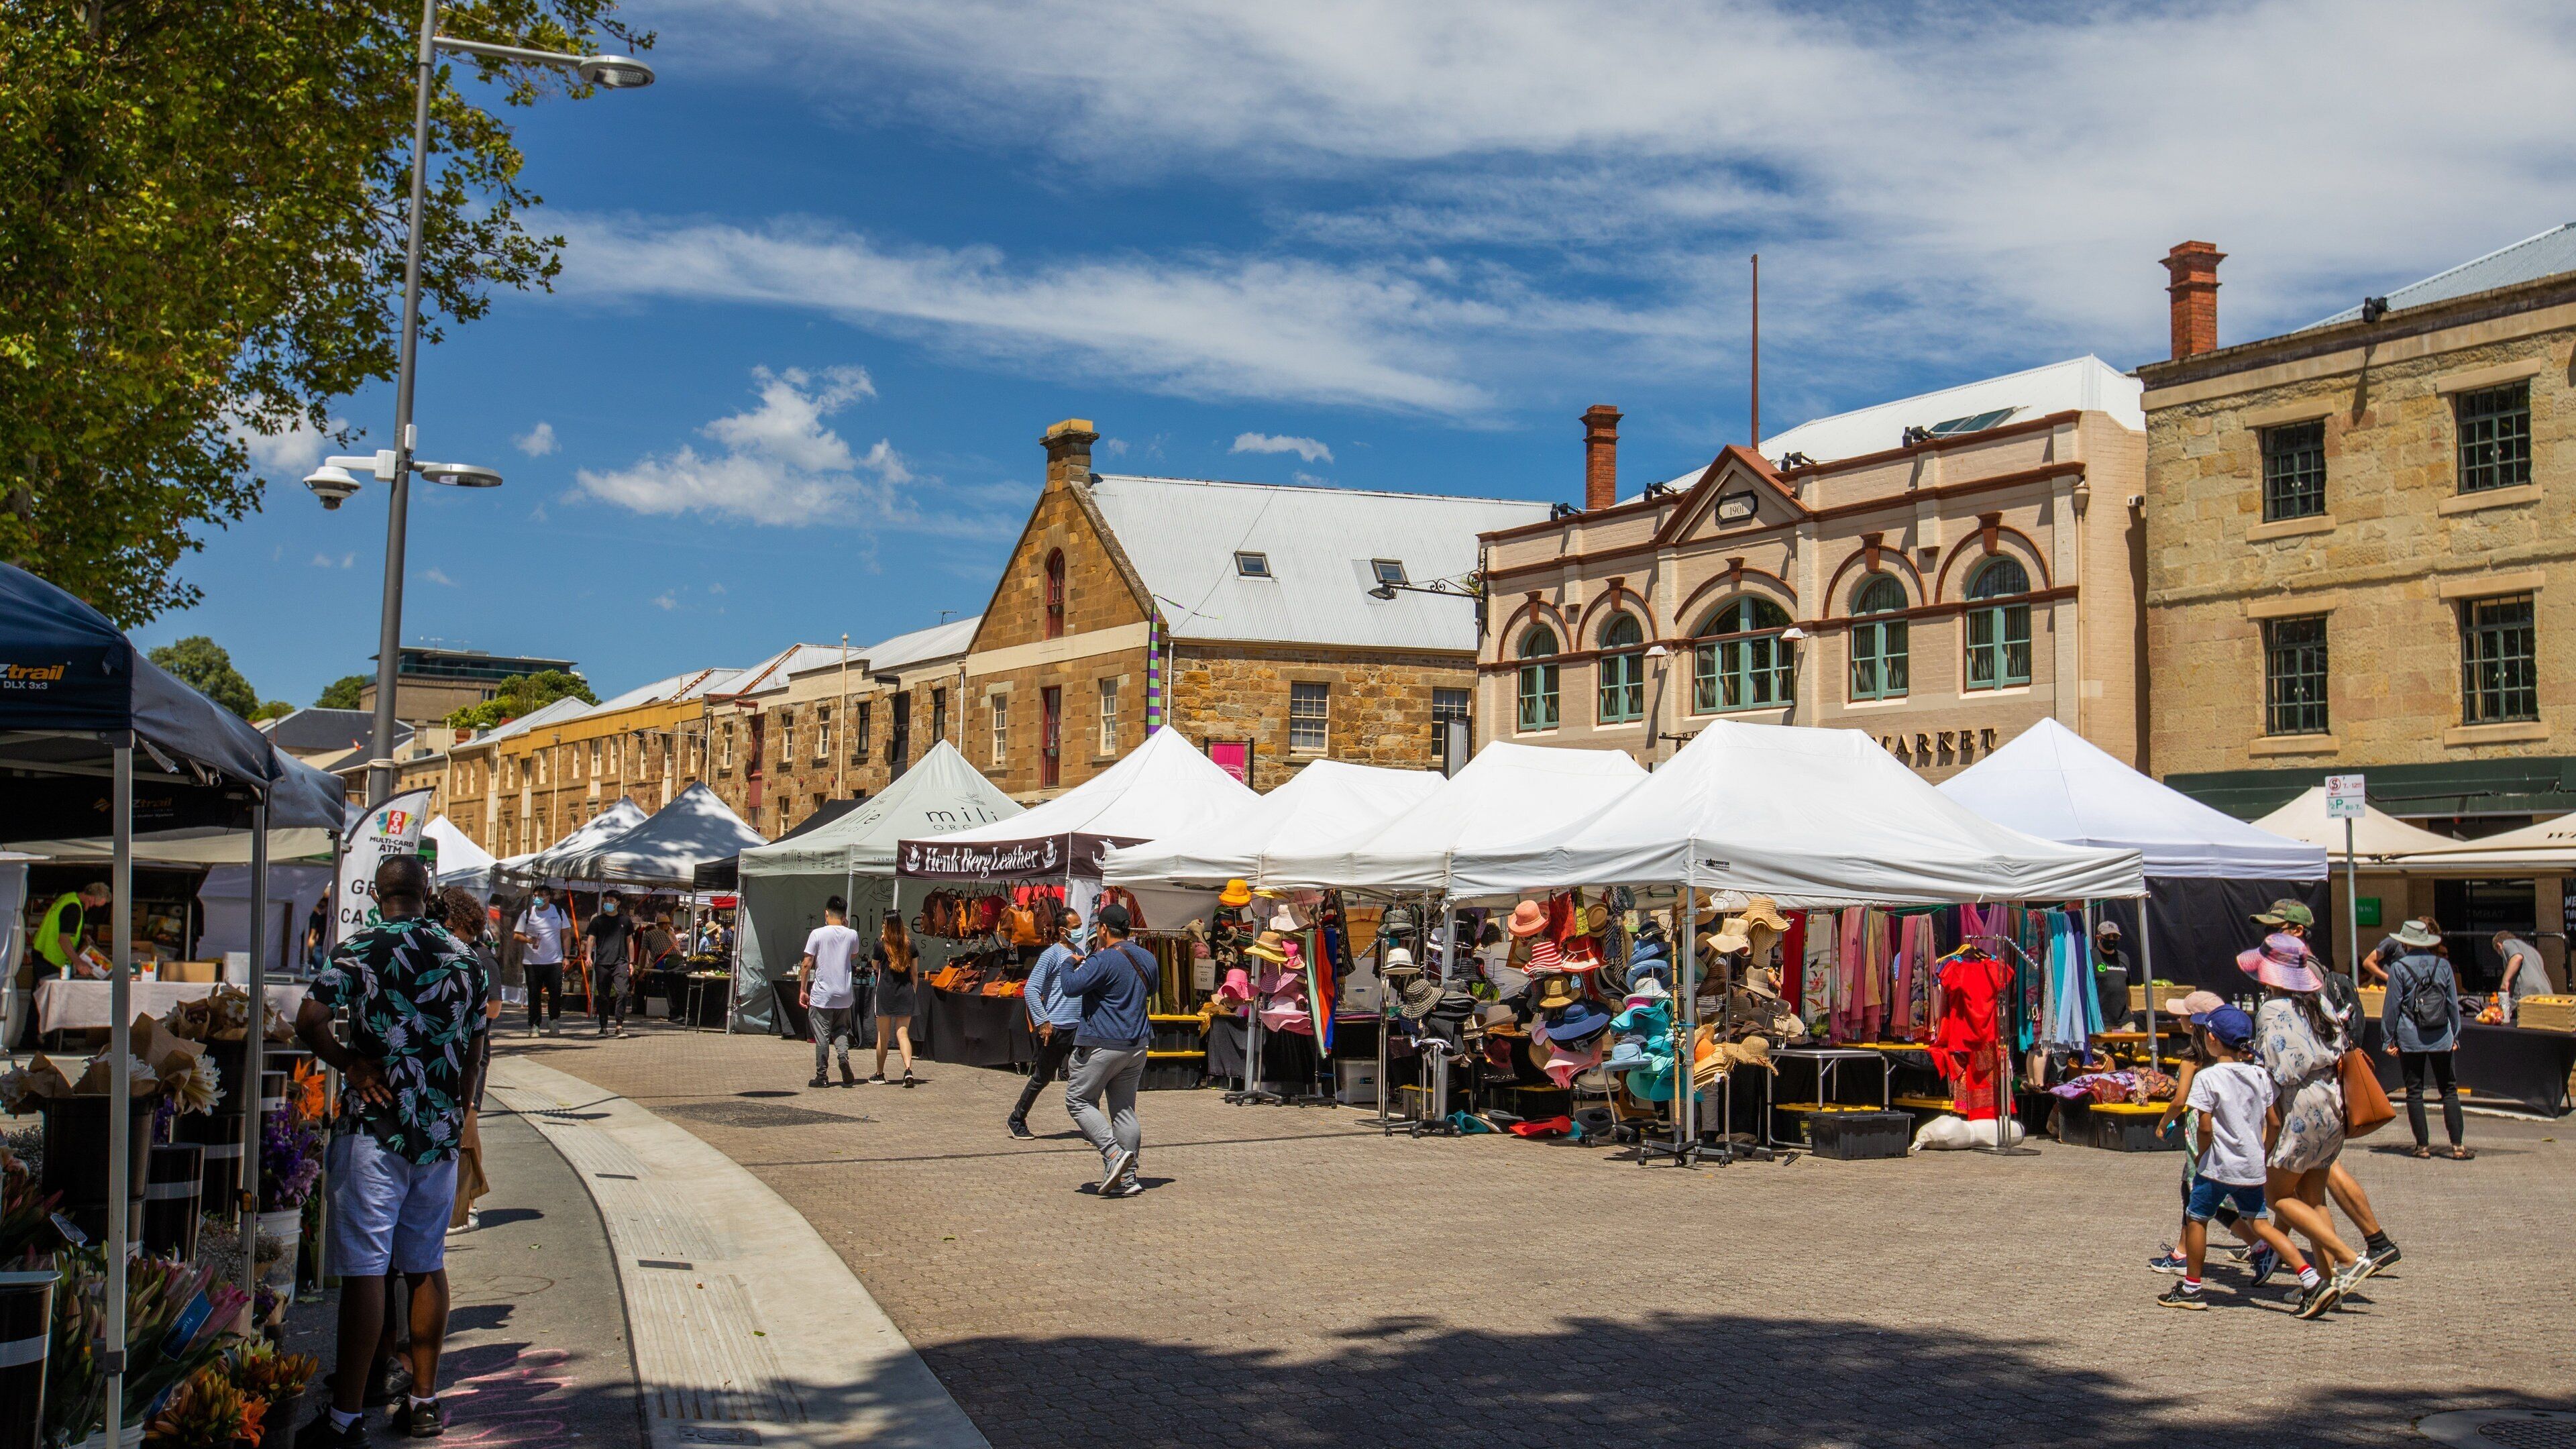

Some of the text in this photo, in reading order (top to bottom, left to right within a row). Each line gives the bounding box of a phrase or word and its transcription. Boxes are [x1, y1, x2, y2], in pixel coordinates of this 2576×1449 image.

[1729, 504, 1743, 516] 1901
[3, 681, 48, 690] DLX 3x3
[925, 807, 998, 823] mili
[389, 812, 402, 834] ATM
[370, 837, 414, 848] MULTI-CARD
[378, 844, 402, 854] ATM
[782, 849, 802, 863] milie
[924, 845, 1038, 878] Henk Berg Leather
[352, 879, 376, 896] GE
[341, 906, 380, 927] CA$
[329, 1421, 347, 1434] PUMA
